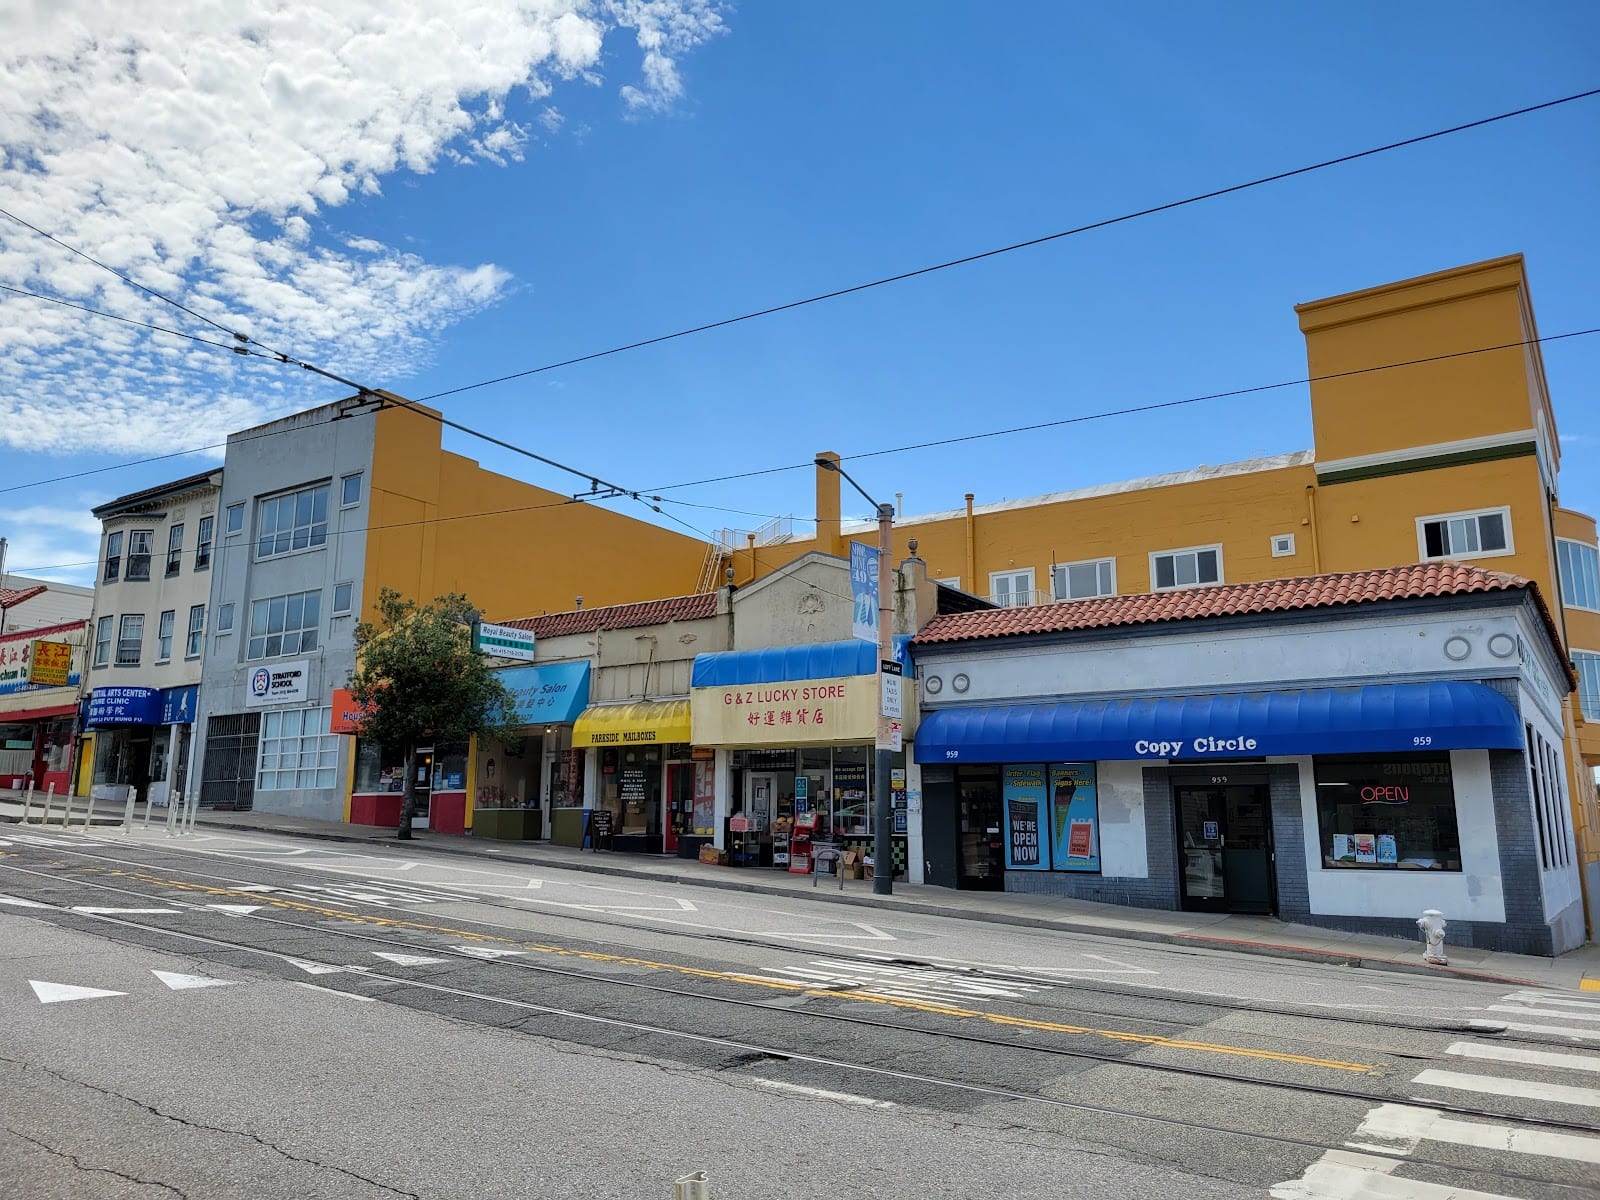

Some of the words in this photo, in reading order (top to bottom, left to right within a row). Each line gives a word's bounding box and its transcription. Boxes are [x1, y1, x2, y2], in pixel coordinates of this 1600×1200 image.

[853, 570, 867, 583] 49
[483, 626, 497, 636] Royal
[499, 629, 518, 640] Beauty
[518, 632, 533, 640] Salon
[37, 643, 69, 658] 長江
[272, 670, 302, 681] STRATFORD
[271, 680, 293, 688] SCHOOL
[539, 683, 568, 694] Salon
[108, 689, 121, 697] ARTS
[122, 689, 147, 698] CENTER
[725, 694, 732, 704] G
[736, 693, 743, 704] &
[746, 692, 753, 703] Z
[758, 689, 798, 703] LUCKY
[803, 686, 845, 700] STORE
[886, 696, 897, 704] ONLY
[748, 708, 824, 726] 好運雜貨店
[592, 733, 619, 743] PARKSIDE
[623, 731, 656, 742] MAILBOXES
[1413, 736, 1432, 746] 959
[1135, 740, 1183, 756] Copy
[1193, 736, 1257, 753] Circle
[946, 750, 959, 759] 959
[1006, 770, 1023, 778] Order
[1012, 779, 1042, 787] Sidewalk
[1054, 779, 1073, 788] Signs
[1360, 786, 1409, 801] OPEN
[1013, 820, 1036, 832] WE'RE
[1013, 832, 1037, 845] OPEN
[1014, 846, 1037, 861] NOW
